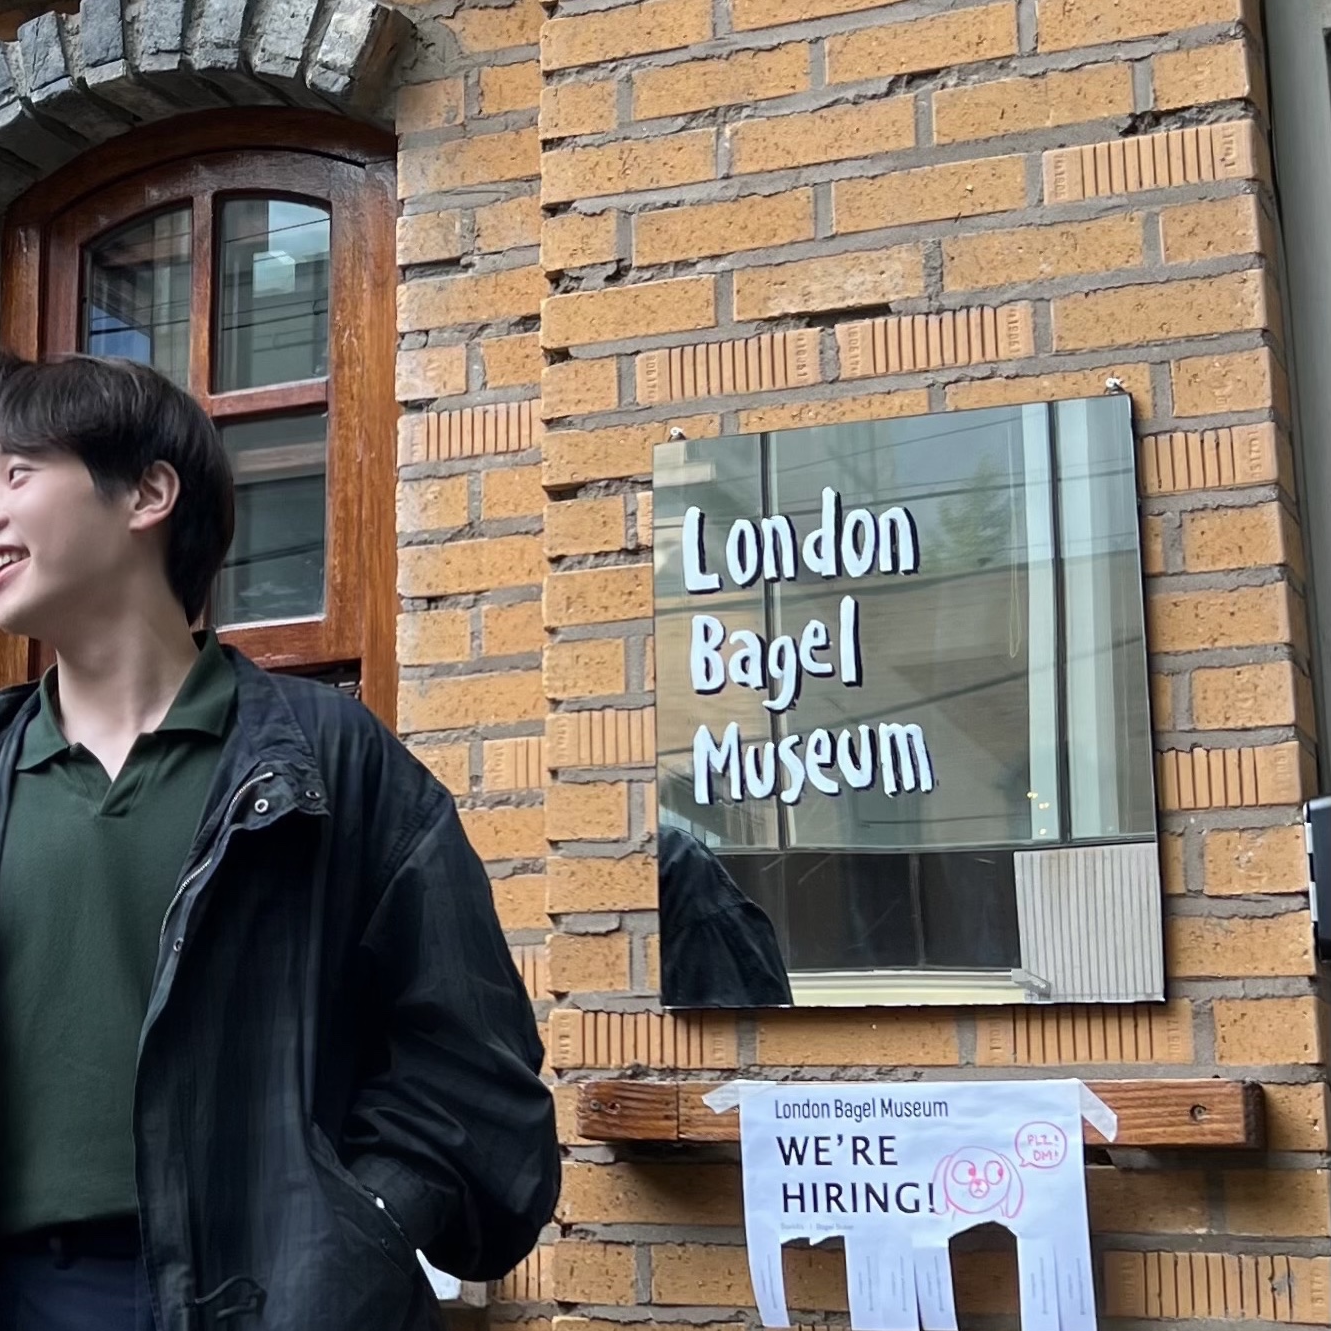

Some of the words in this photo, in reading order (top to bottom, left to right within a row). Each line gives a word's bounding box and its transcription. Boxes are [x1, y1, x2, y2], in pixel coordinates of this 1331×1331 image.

[682, 486, 919, 593] London
[690, 595, 863, 713] Bagel
[692, 720, 934, 804] Museum
[775, 1099, 830, 1119] London
[834, 1098, 876, 1123] Bagel
[880, 1098, 949, 1118] Museum
[776, 1134, 898, 1166] WE'RE
[782, 1182, 936, 1214] HIRING!
